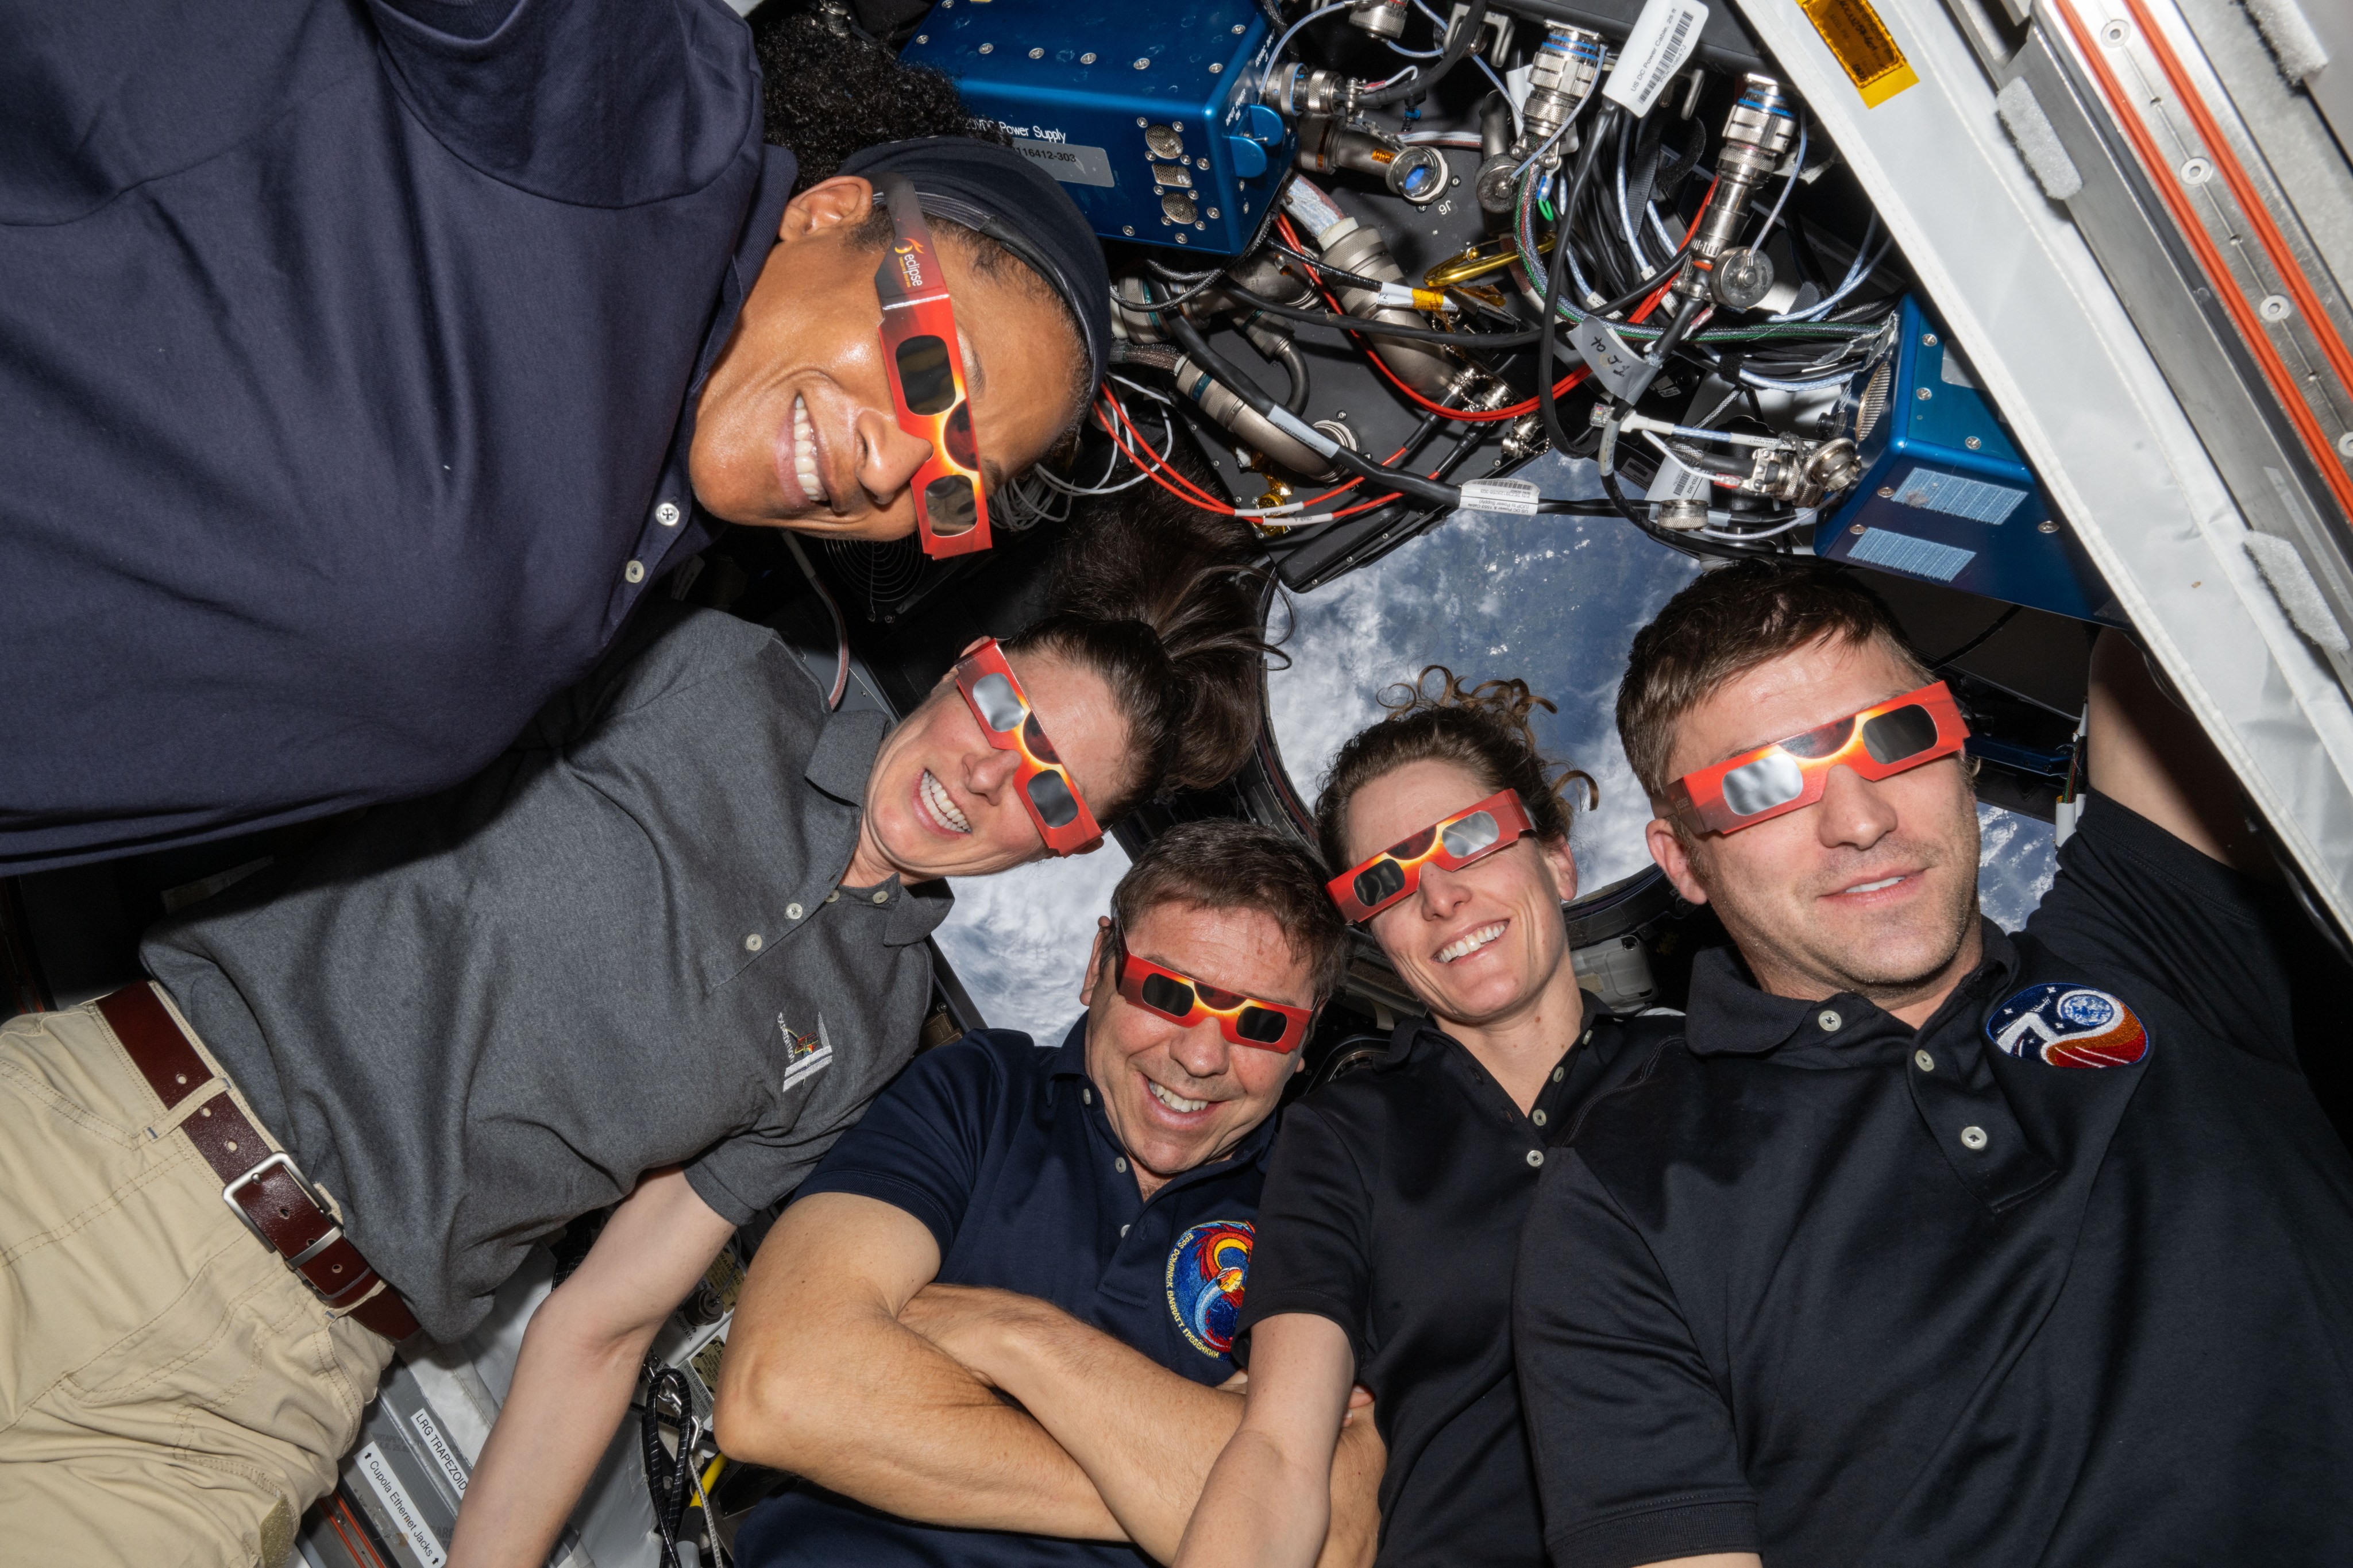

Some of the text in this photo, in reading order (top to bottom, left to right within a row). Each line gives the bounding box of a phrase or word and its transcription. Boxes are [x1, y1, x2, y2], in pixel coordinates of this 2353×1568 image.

[1255, 29, 1275, 67] 120VDC INPUT
[1631, 81, 1639, 91] US
[1637, 69, 1645, 80] DC
[1643, 47, 1657, 68] Power
[1667, 14, 1673, 24] 25
[1225, 88, 1246, 126] INPUT POWER
[1235, 110, 1240, 121] ON
[998, 121, 1028, 136] Power
[1033, 126, 1066, 144] Supply
[1437, 199, 1453, 215] J6
[904, 254, 923, 287] eclipse
[719, 1253, 741, 1285] WARNG
[1166, 1249, 1179, 1288] DOMINICK
[1166, 1290, 1185, 1328] BARRATT
[713, 1345, 724, 1360] CAU
[683, 1364, 696, 1380] UTILITY
[693, 1378, 706, 1395] OUTLET
[703, 1394, 715, 1408] PANEL
[686, 1381, 701, 1401] SECONDARY
[699, 1400, 709, 1413] POWER
[416, 1413, 466, 1490] LRG TRAPEZOID
[370, 1461, 433, 1557] Cupola Ethernet Jacks
